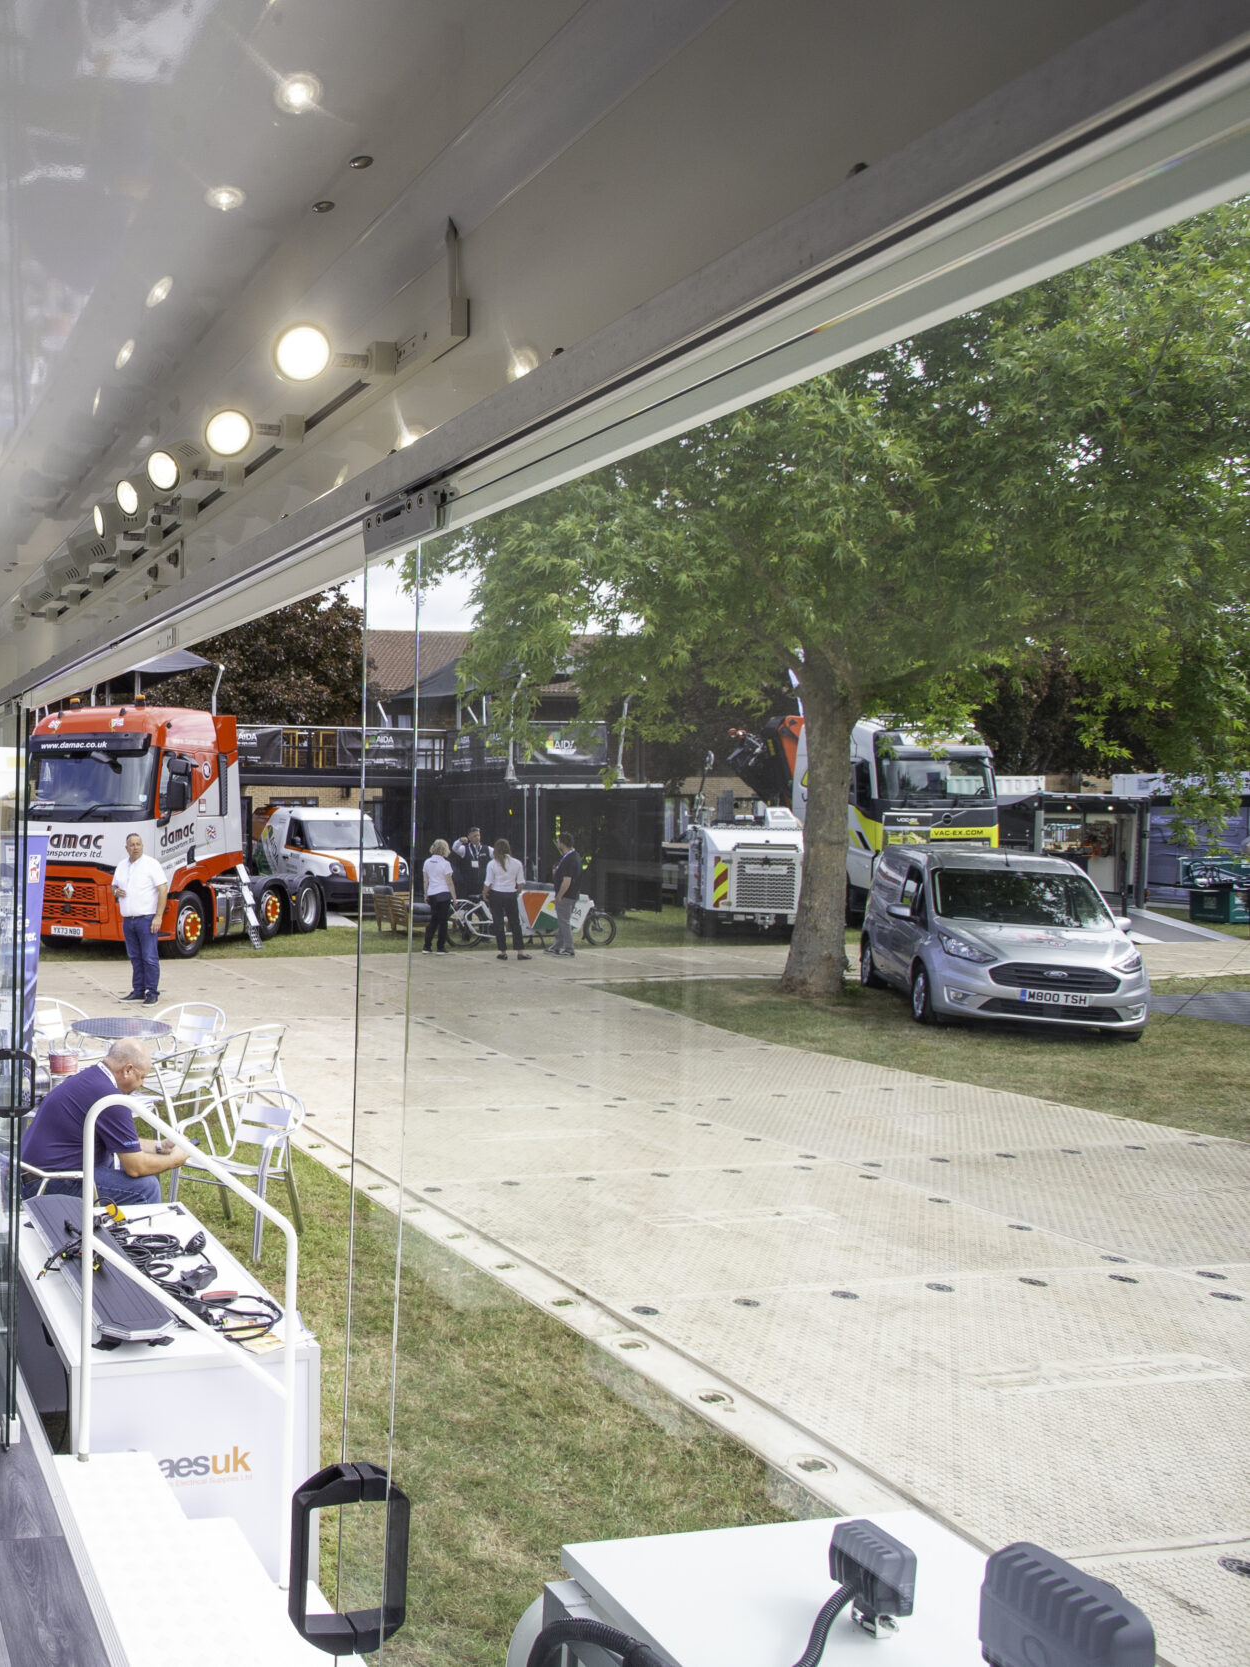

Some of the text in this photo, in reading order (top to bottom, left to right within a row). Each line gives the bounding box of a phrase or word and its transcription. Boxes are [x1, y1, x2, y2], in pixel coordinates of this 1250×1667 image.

[376, 735, 394, 744] AIDA
[41, 741, 107, 750] www.damac.co.uk
[47, 825, 104, 849] amac
[160, 822, 194, 847] damac
[47, 850, 103, 858] ansporters ltd.
[53, 927, 68, 935] YX73
[1027, 991, 1087, 1005] M800 TSH
[158, 1446, 251, 1478] aesuk
